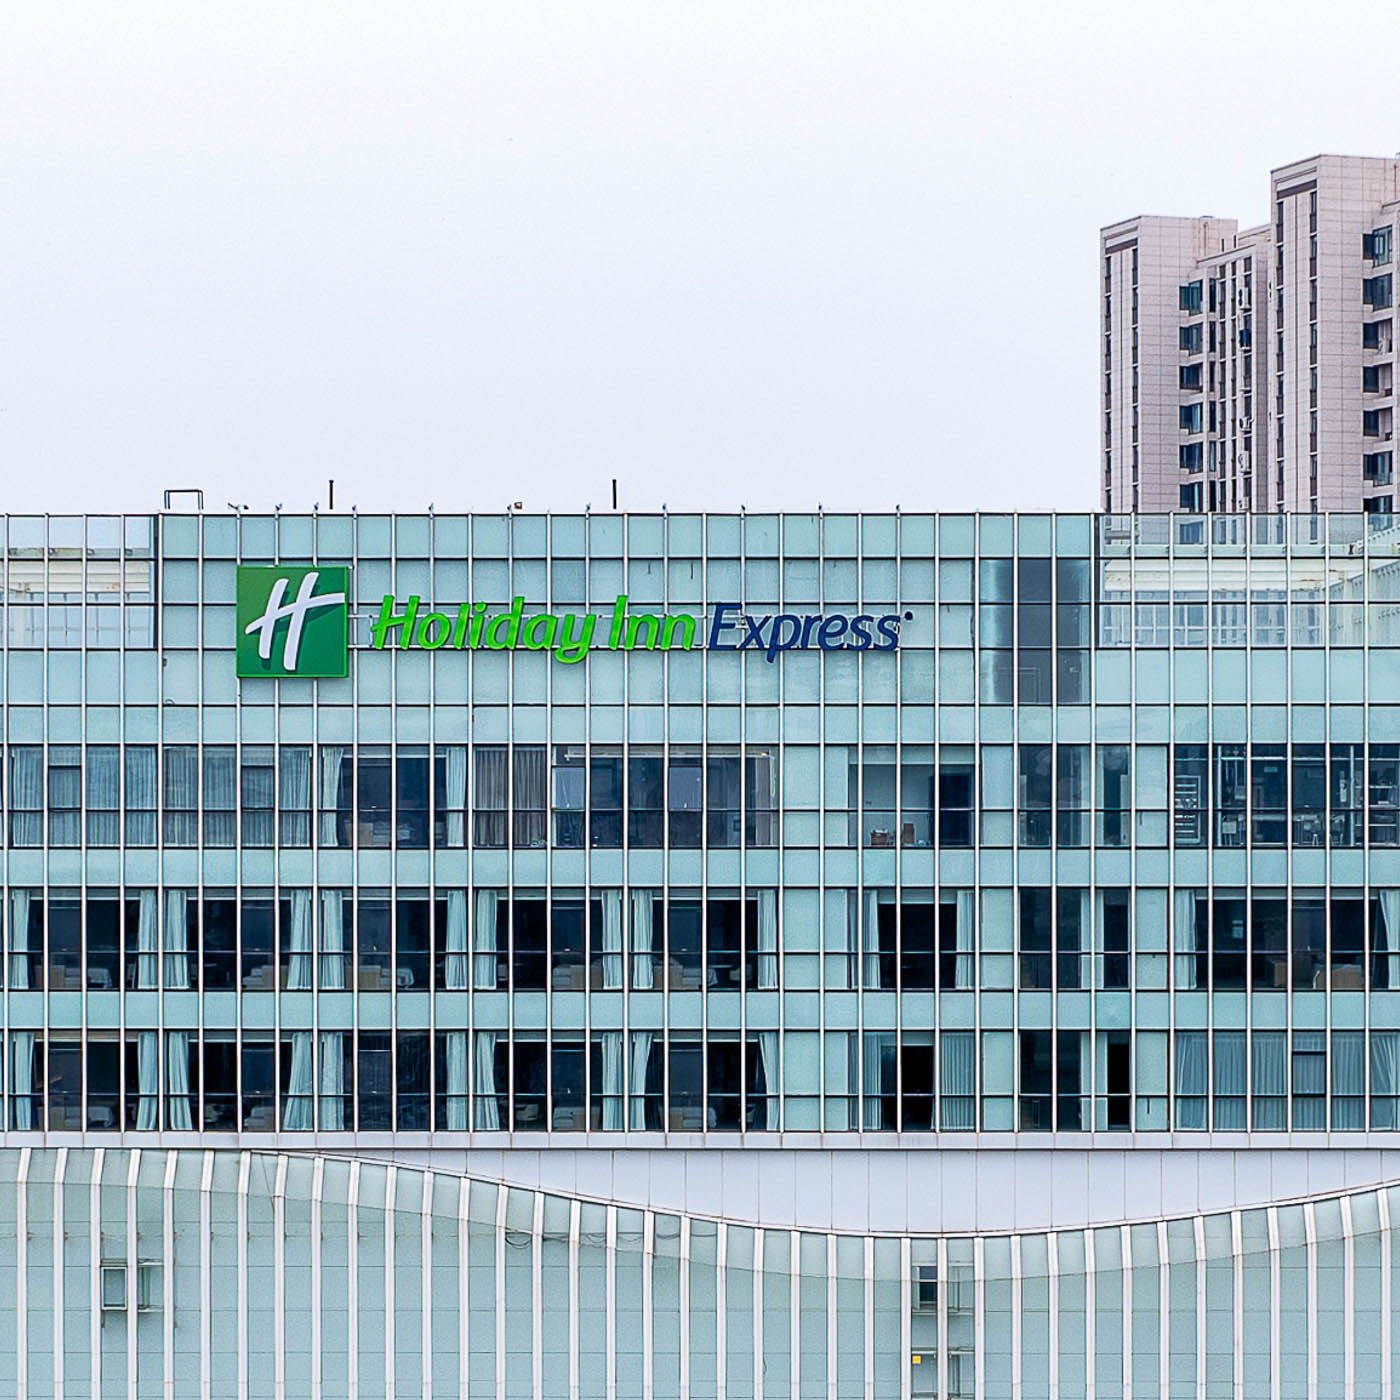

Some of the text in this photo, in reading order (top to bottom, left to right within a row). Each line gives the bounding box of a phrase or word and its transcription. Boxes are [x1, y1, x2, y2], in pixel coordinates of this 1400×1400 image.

[369, 595, 901, 664] Holiday Inn Express
